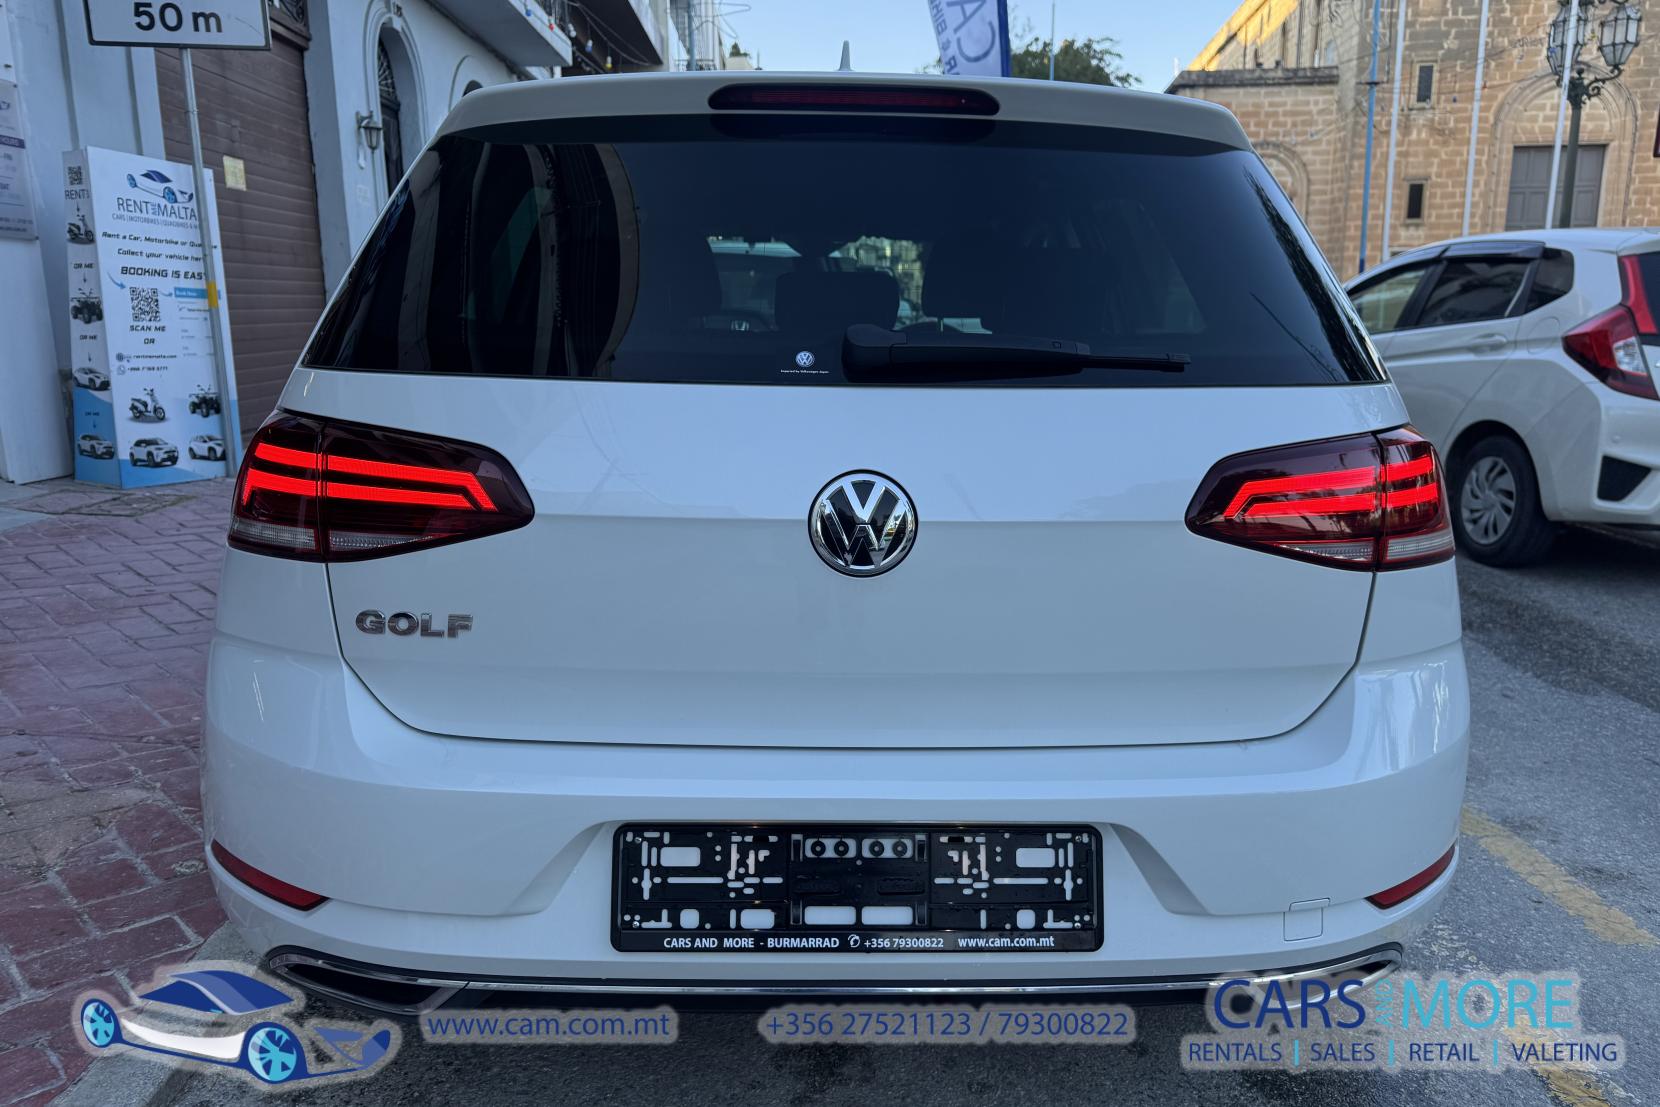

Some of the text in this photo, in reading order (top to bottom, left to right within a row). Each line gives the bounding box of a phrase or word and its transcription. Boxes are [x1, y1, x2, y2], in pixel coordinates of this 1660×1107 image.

[134, 2, 222, 33] 50 m
[116, 197, 152, 215] RENT
[157, 203, 197, 221] MALTA
[102, 231, 120, 239] Rent
[117, 248, 143, 257] Collect
[121, 266, 168, 278] BOOKING
[171, 270, 181, 279] IS
[355, 609, 474, 638] GOLF
[663, 937, 691, 949] CARS
[694, 937, 718, 949] AND
[723, 937, 755, 949] MORE
[767, 937, 840, 949] BURMARRAD
[864, 937, 890, 949] +356
[893, 937, 944, 949] 79300822
[958, 935, 1055, 949] www.cam.com.mt
